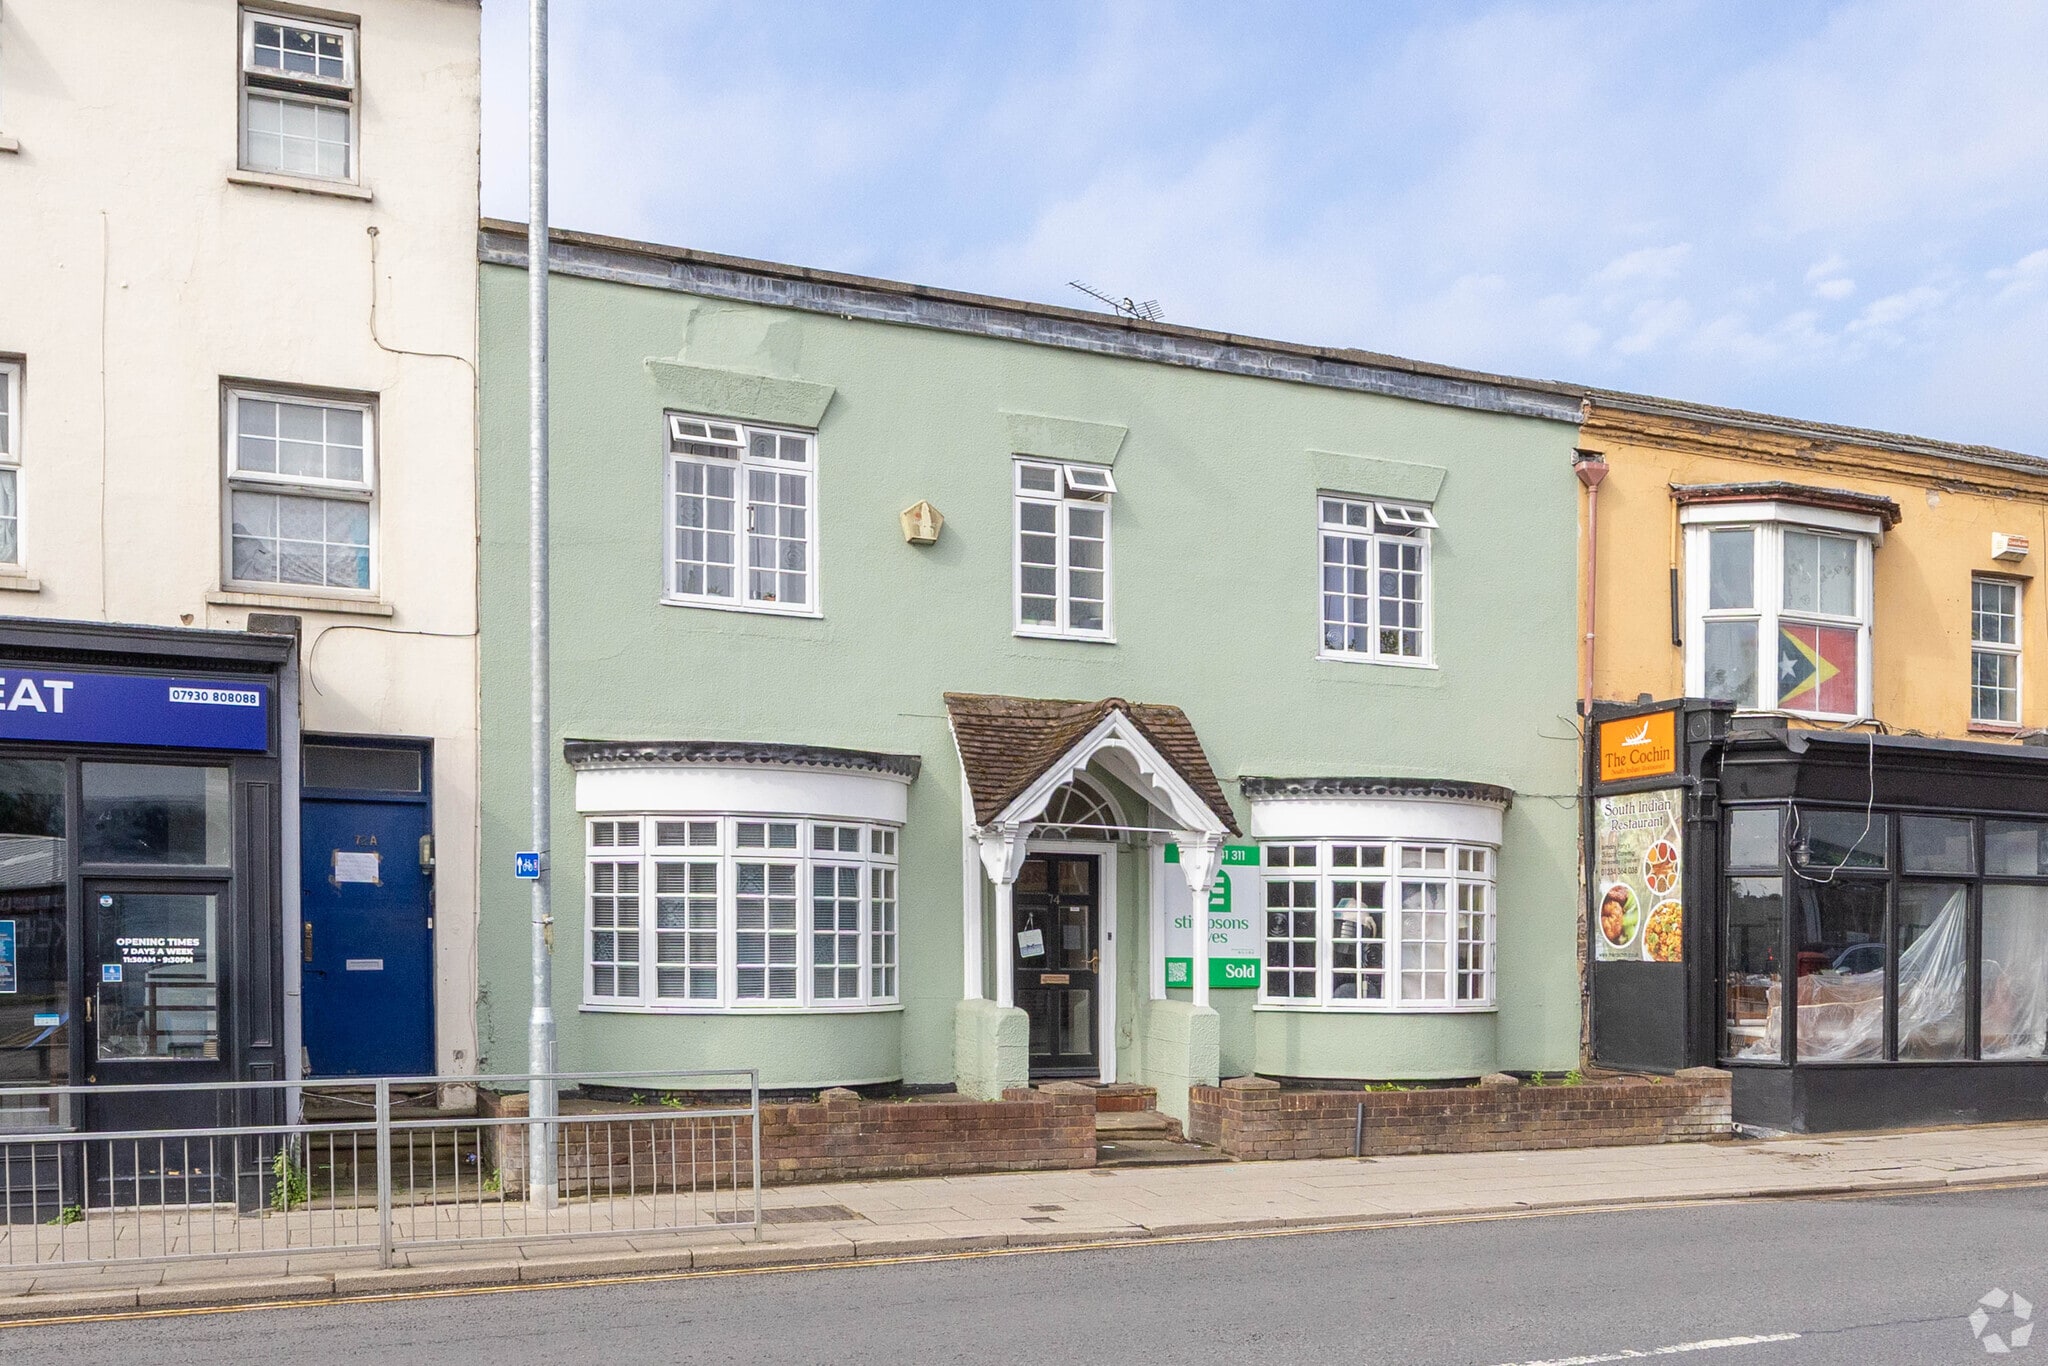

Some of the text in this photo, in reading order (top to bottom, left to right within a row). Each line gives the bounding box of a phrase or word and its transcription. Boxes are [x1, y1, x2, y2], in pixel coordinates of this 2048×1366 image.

[0, 678, 74, 713] AT
[172, 689, 256, 704] 07930 808088
[1605, 746, 1670, 768] The Cochin
[1604, 800, 1671, 816] South Indian
[1611, 817, 1664, 830] Restaurant
[1231, 850, 1246, 861] 311
[1047, 892, 1061, 905] 74
[1174, 915, 1249, 933] stipsons
[116, 937, 200, 946] OPENING TIMES
[122, 956, 156, 964] 11:30AM
[162, 956, 194, 964] 9:30PM
[1225, 963, 1256, 979] Sold
